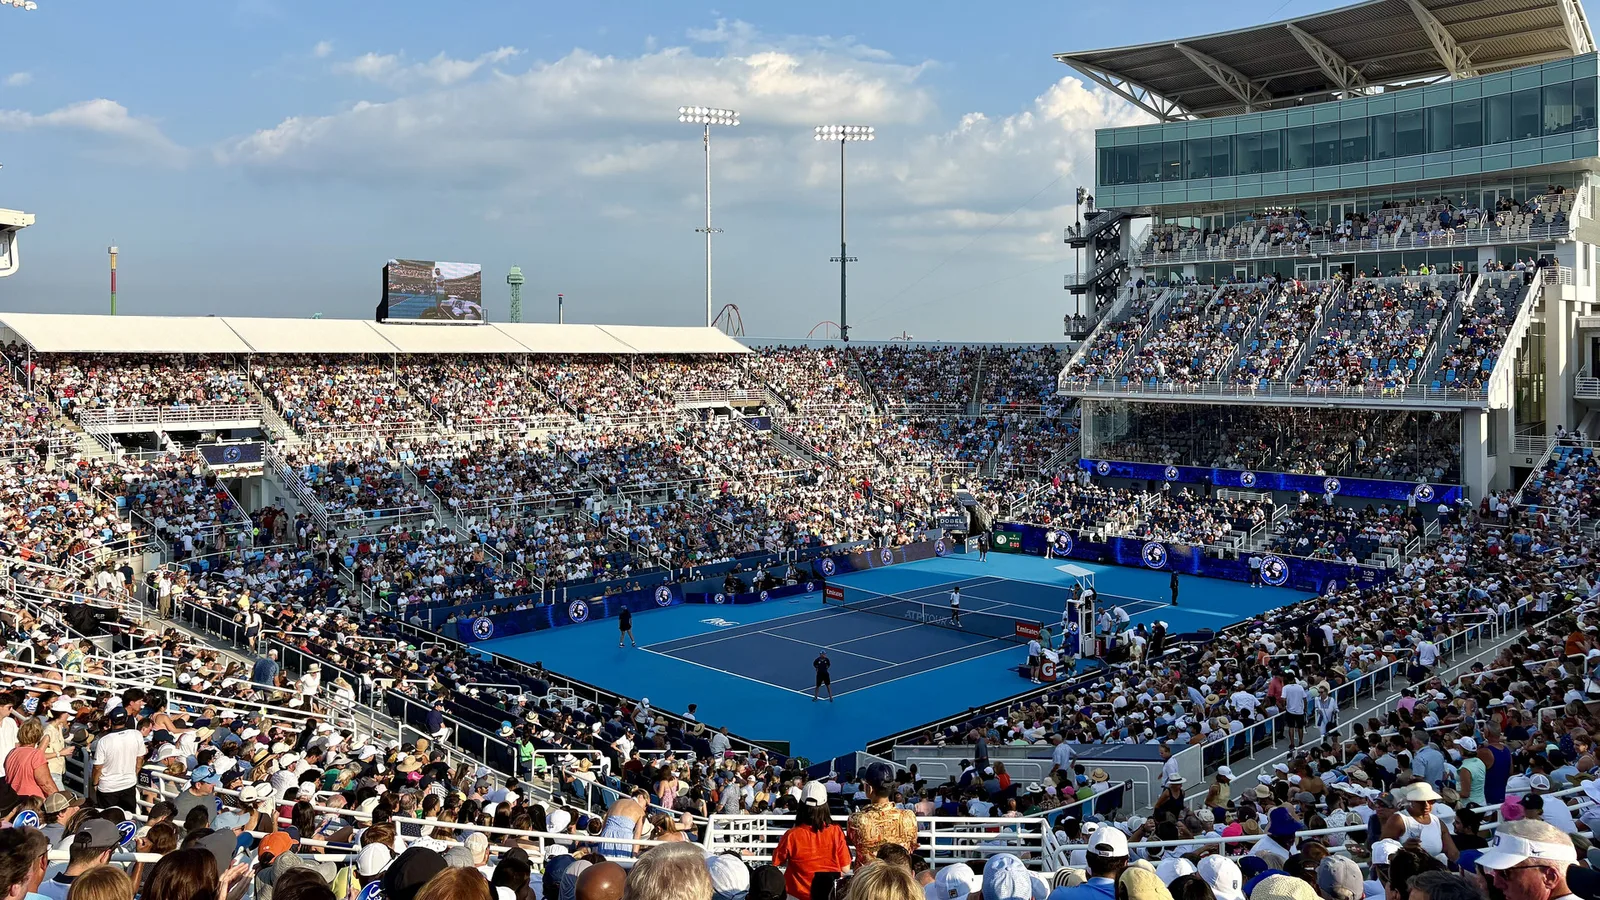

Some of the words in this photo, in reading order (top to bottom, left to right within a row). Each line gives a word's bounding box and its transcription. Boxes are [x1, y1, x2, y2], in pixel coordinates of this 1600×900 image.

[826, 588, 843, 597] Emirates
[1016, 625, 1039, 636] Emirates
[1042, 662, 1054, 677] G
